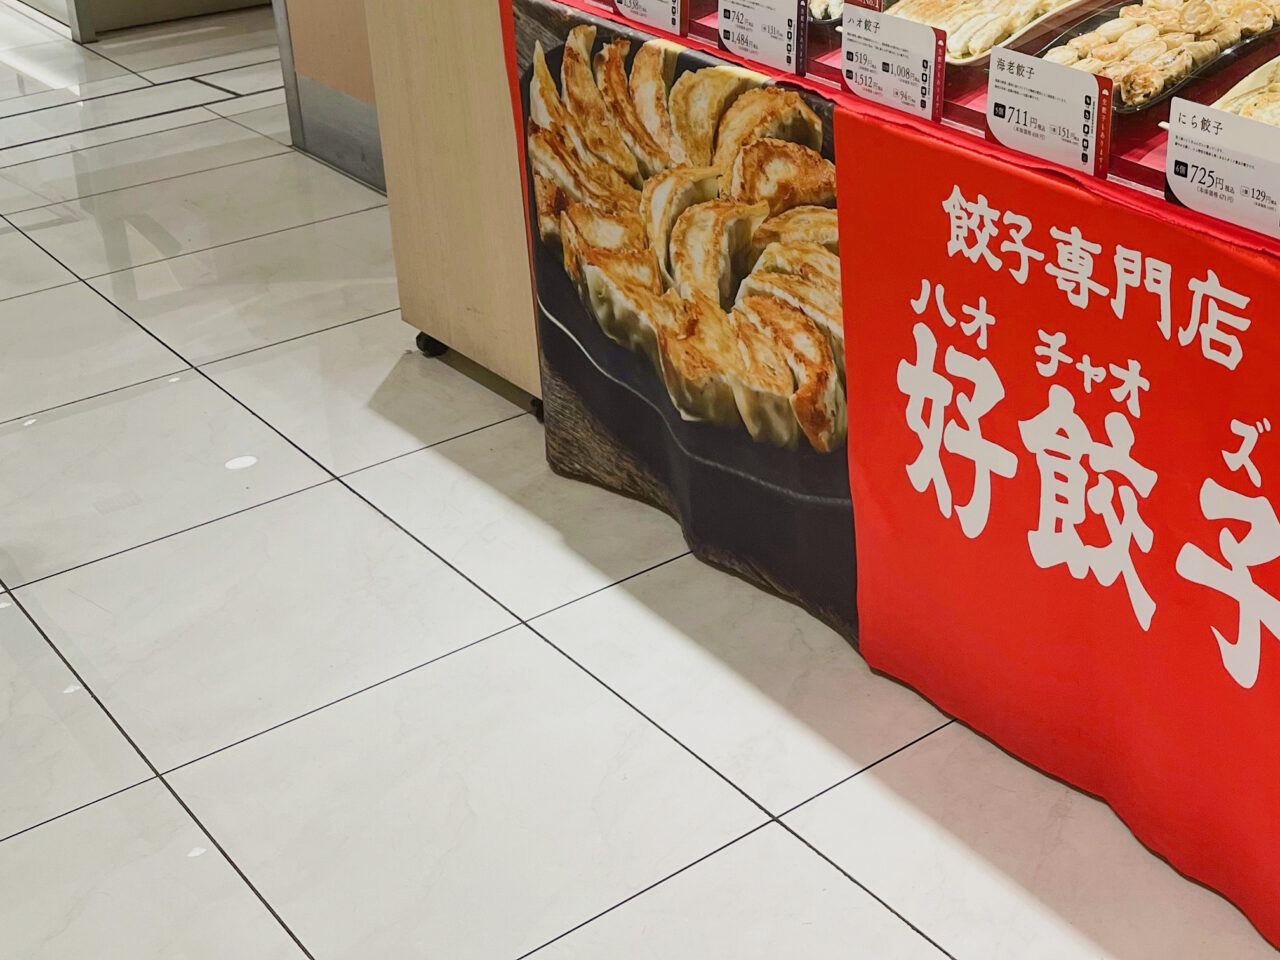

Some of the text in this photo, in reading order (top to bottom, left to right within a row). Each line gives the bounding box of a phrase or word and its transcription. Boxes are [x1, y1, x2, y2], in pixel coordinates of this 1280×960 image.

[848, 18, 880, 34] ハオ餃子
[996, 57, 1035, 80] 海老餃子
[1179, 112, 1223, 136] にら餃子
[942, 185, 1251, 370] 餃子専門店
[910, 279, 1272, 487] ハオ チャオ ズ
